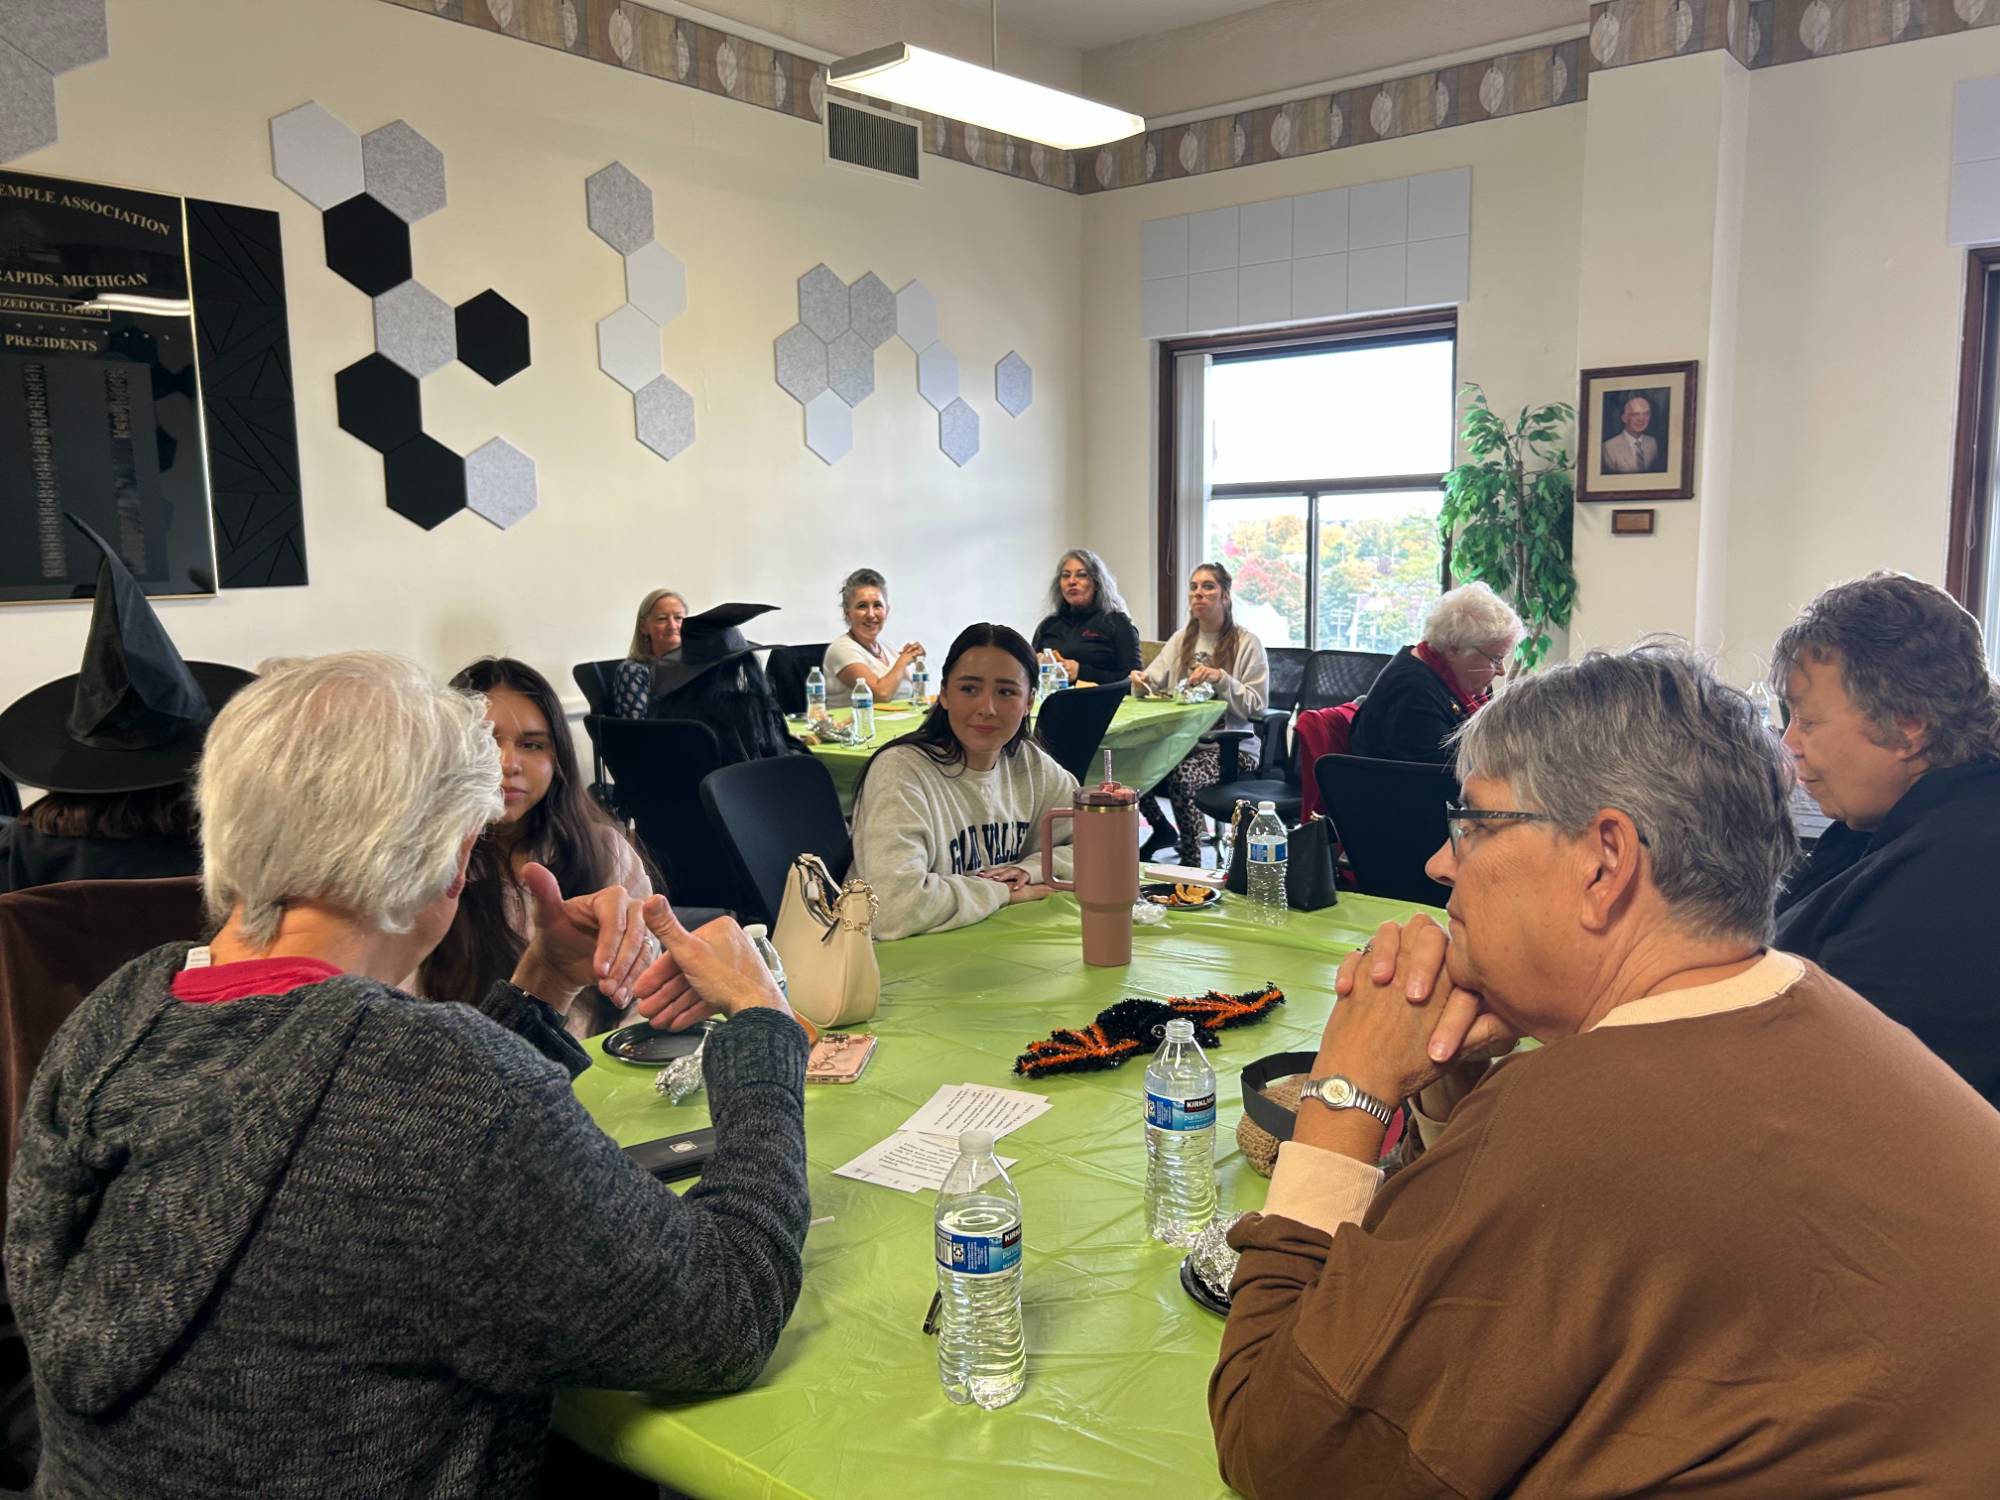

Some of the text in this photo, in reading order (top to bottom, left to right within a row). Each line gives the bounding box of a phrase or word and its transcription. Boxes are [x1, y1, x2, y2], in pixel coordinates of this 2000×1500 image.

[60, 194, 171, 236] ASSOCIATION
[62, 273, 149, 288] MICHIGAN
[5, 334, 98, 352] PRESIDENTS
